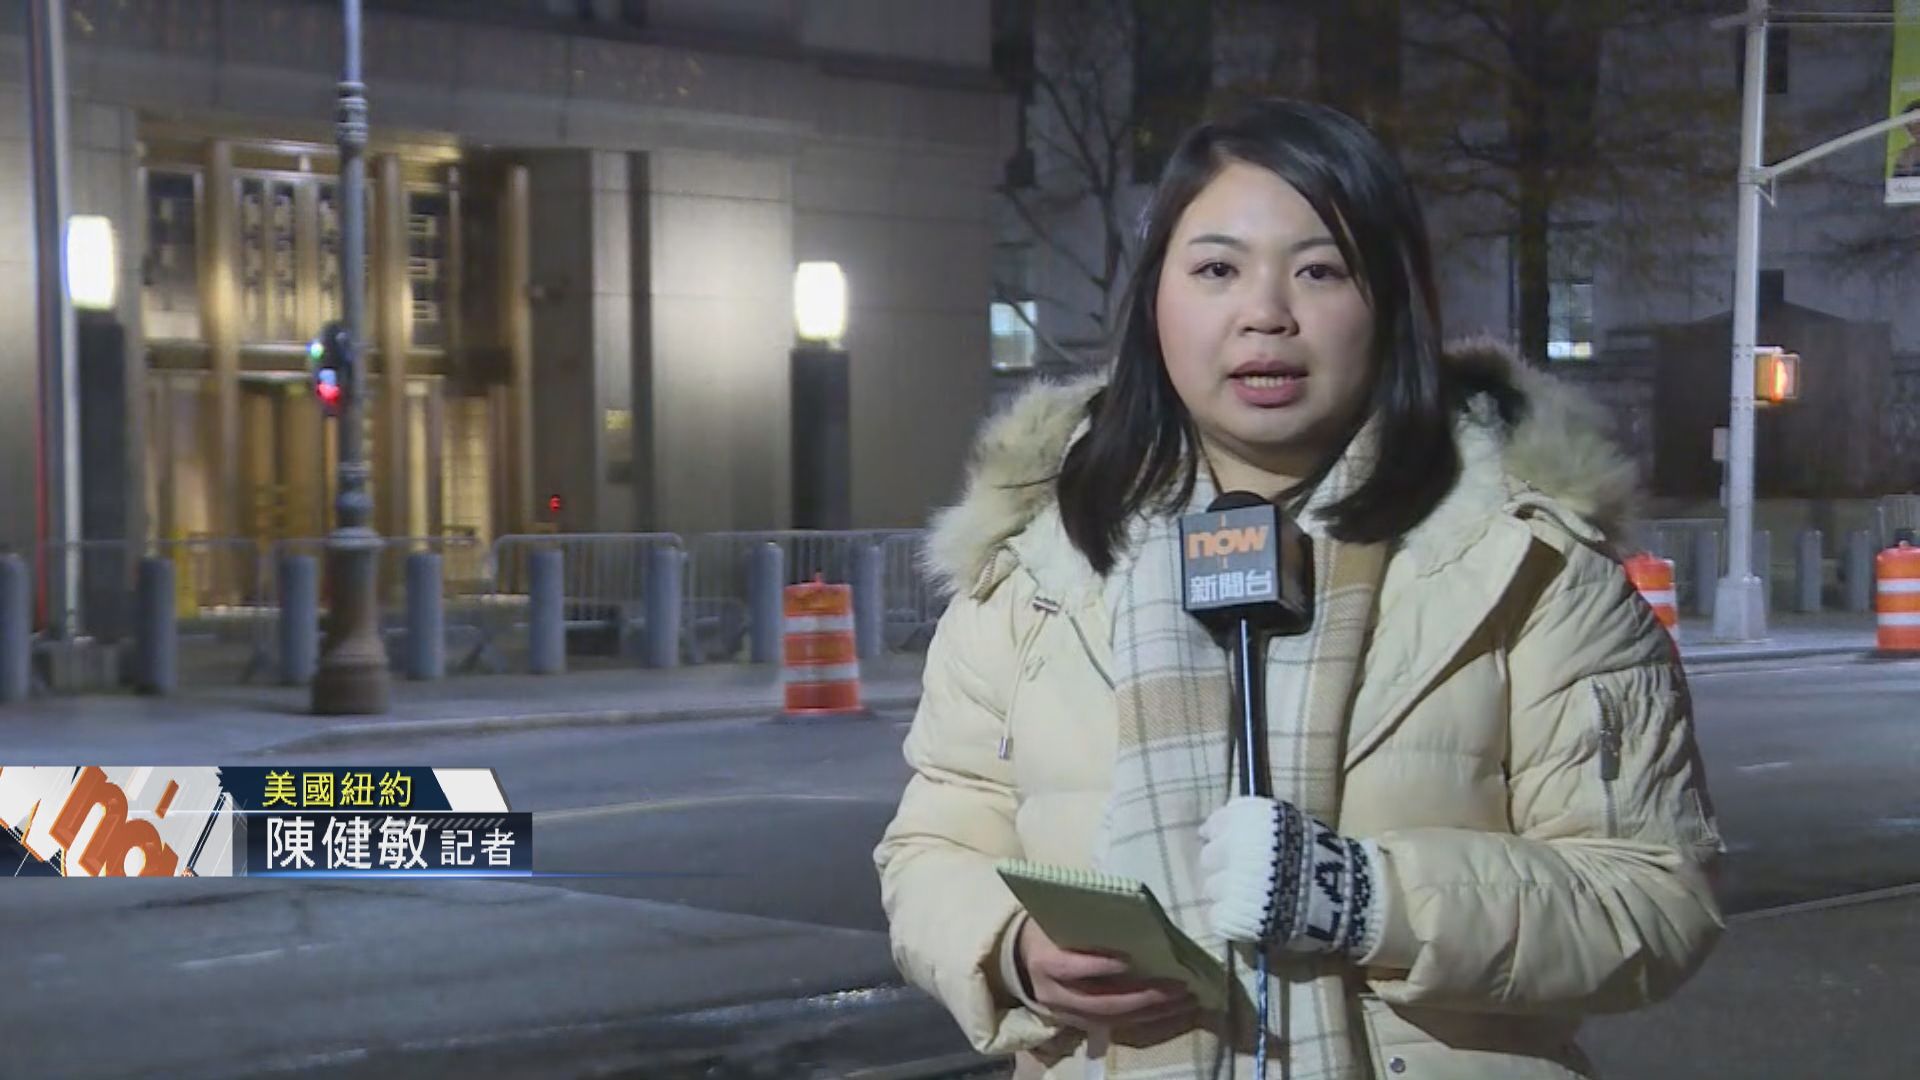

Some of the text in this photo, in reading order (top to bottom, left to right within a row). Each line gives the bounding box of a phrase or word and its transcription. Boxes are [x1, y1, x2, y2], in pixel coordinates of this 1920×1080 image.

[1188, 525, 1269, 560] now
[1190, 570, 1272, 603] 新聞台
